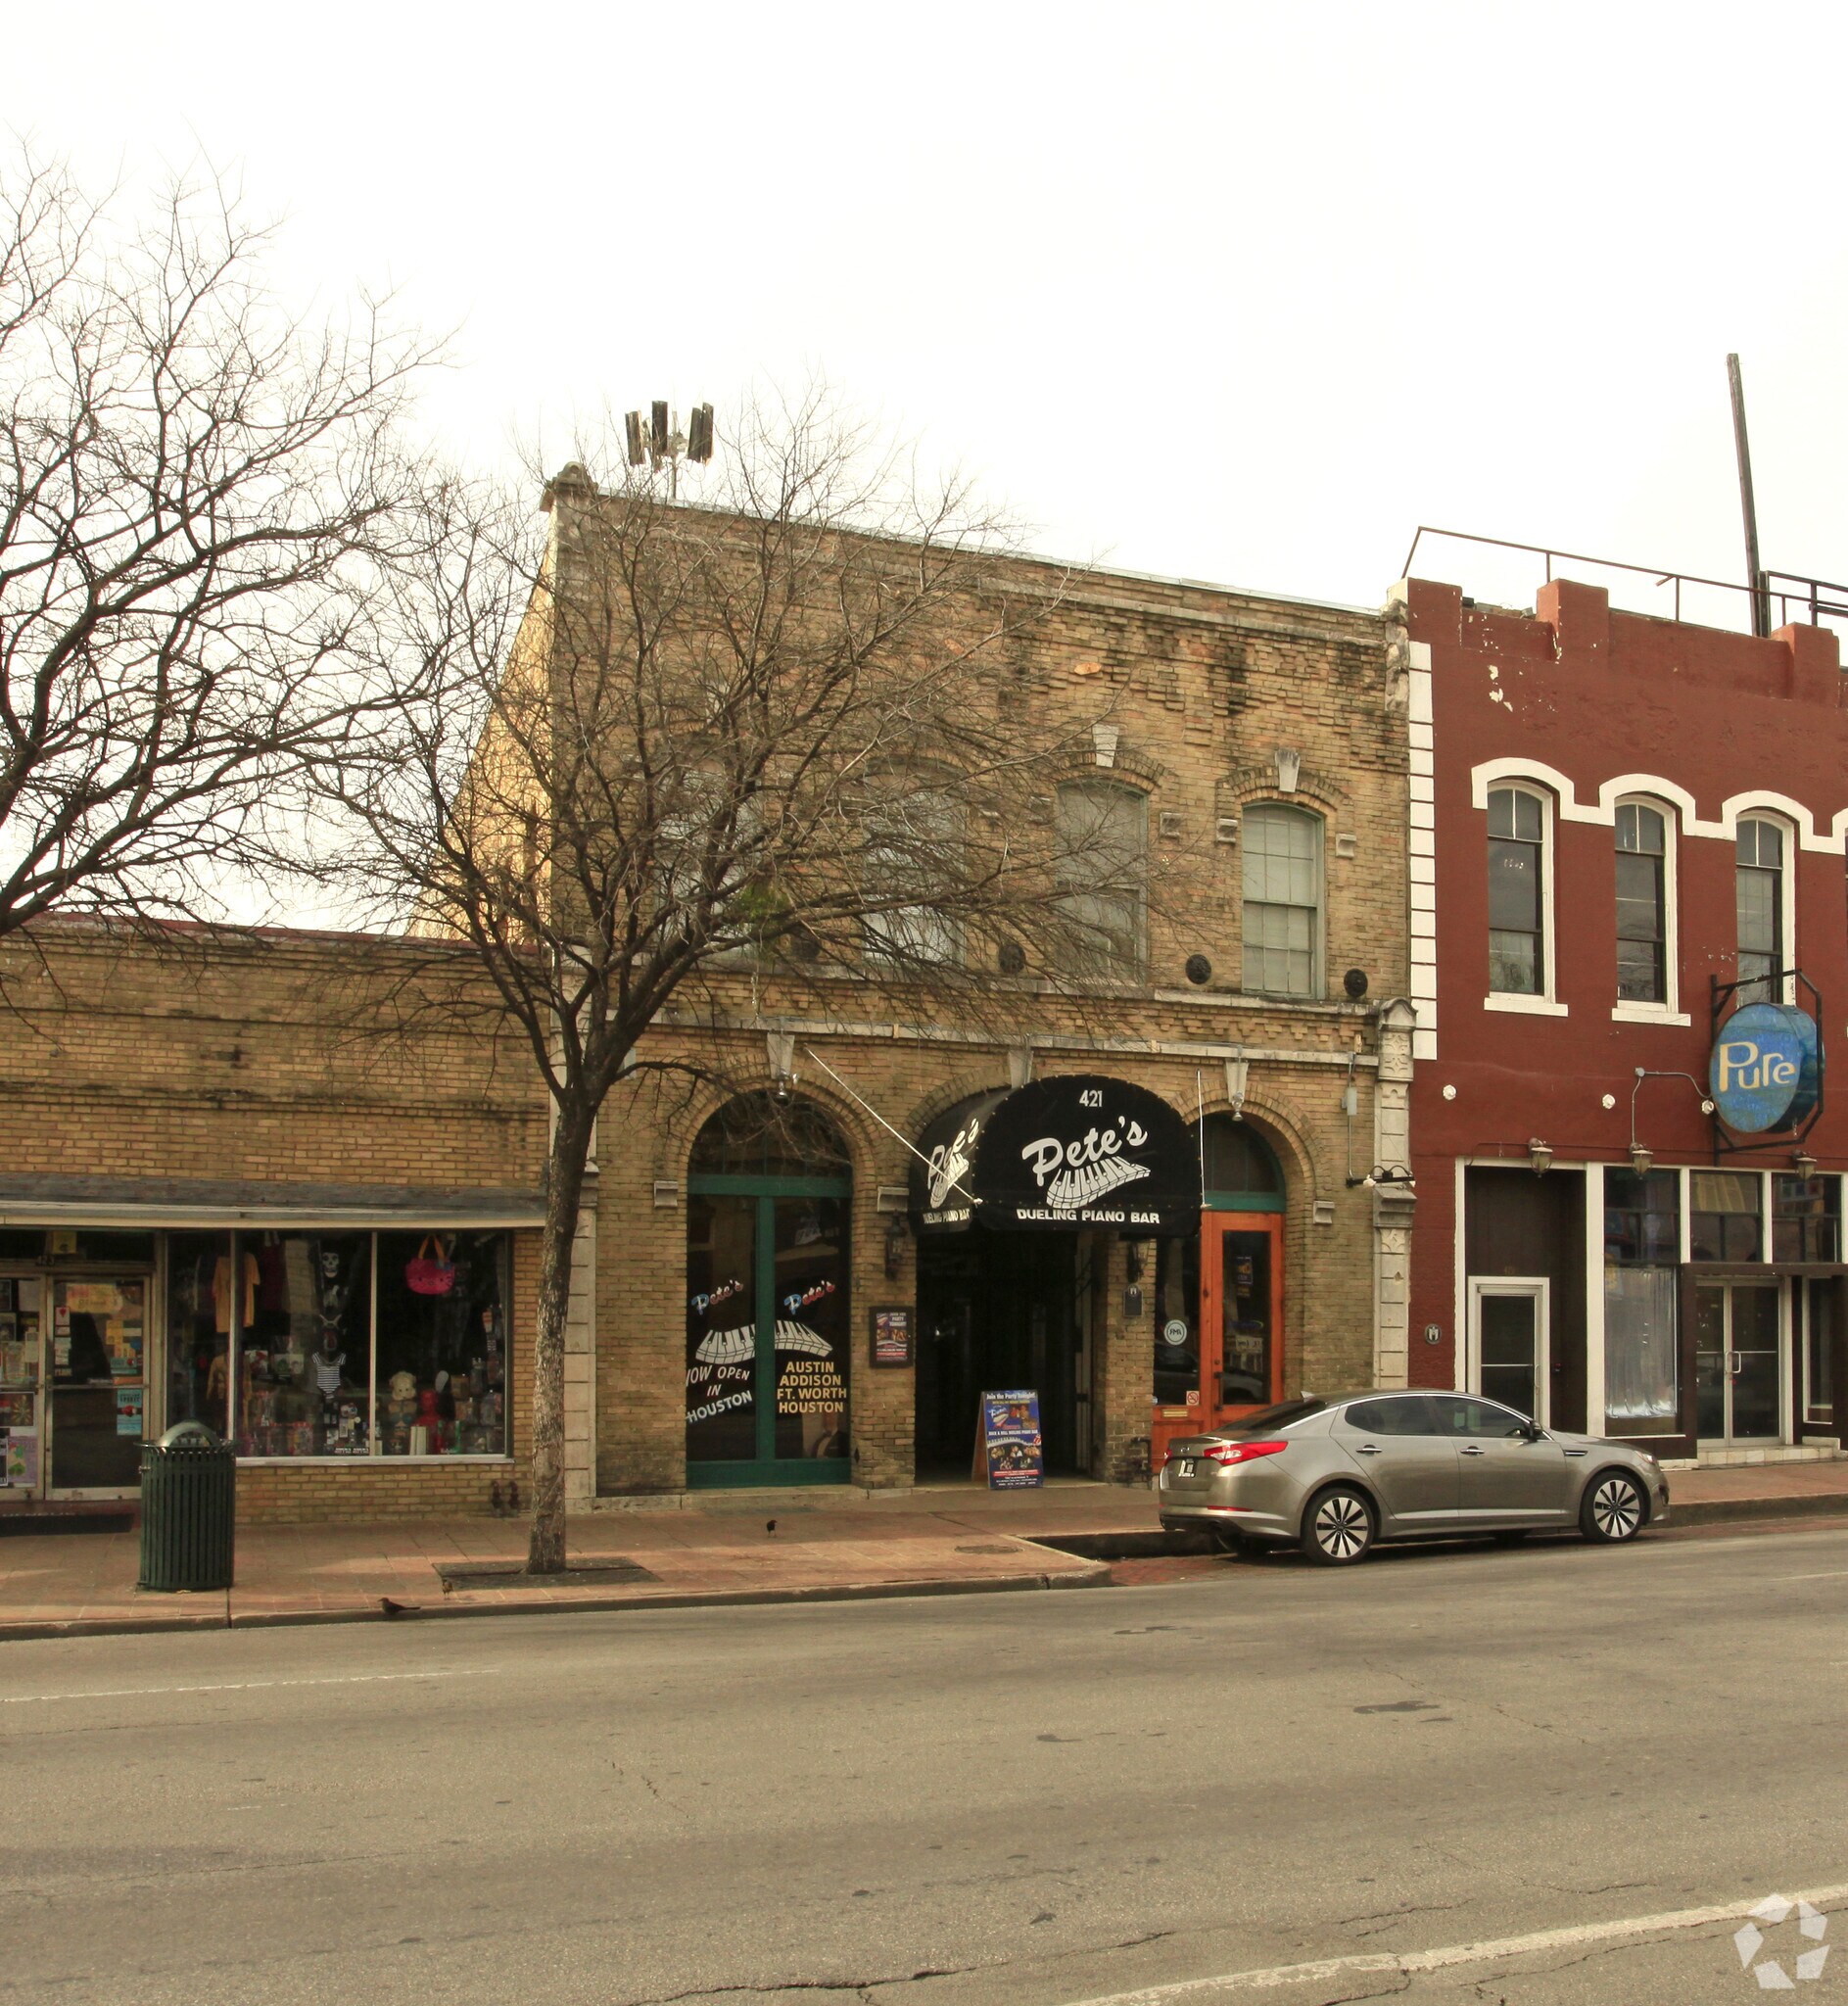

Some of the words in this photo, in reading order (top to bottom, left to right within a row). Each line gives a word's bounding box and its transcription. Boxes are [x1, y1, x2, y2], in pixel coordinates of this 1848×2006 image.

[1719, 1041, 1796, 1092] Pure
[1079, 1089, 1103, 1107] 421
[1021, 1116, 1148, 1187] Pete's
[1017, 1209, 1077, 1220] DUELING
[1081, 1210, 1125, 1222] PIANO
[1130, 1212, 1161, 1223] BAR
[690, 1279, 744, 1314] Pete's
[783, 1279, 835, 1314] Pete's
[717, 1365, 750, 1381] OPEN
[785, 1361, 834, 1373] AUSTIN
[780, 1374, 841, 1386] ADDISON
[706, 1384, 722, 1397] IN
[777, 1388, 795, 1400] FT.
[798, 1387, 847, 1400] WORTH
[687, 1390, 753, 1423] HOUSTON
[779, 1402, 844, 1413] HOUSTON
